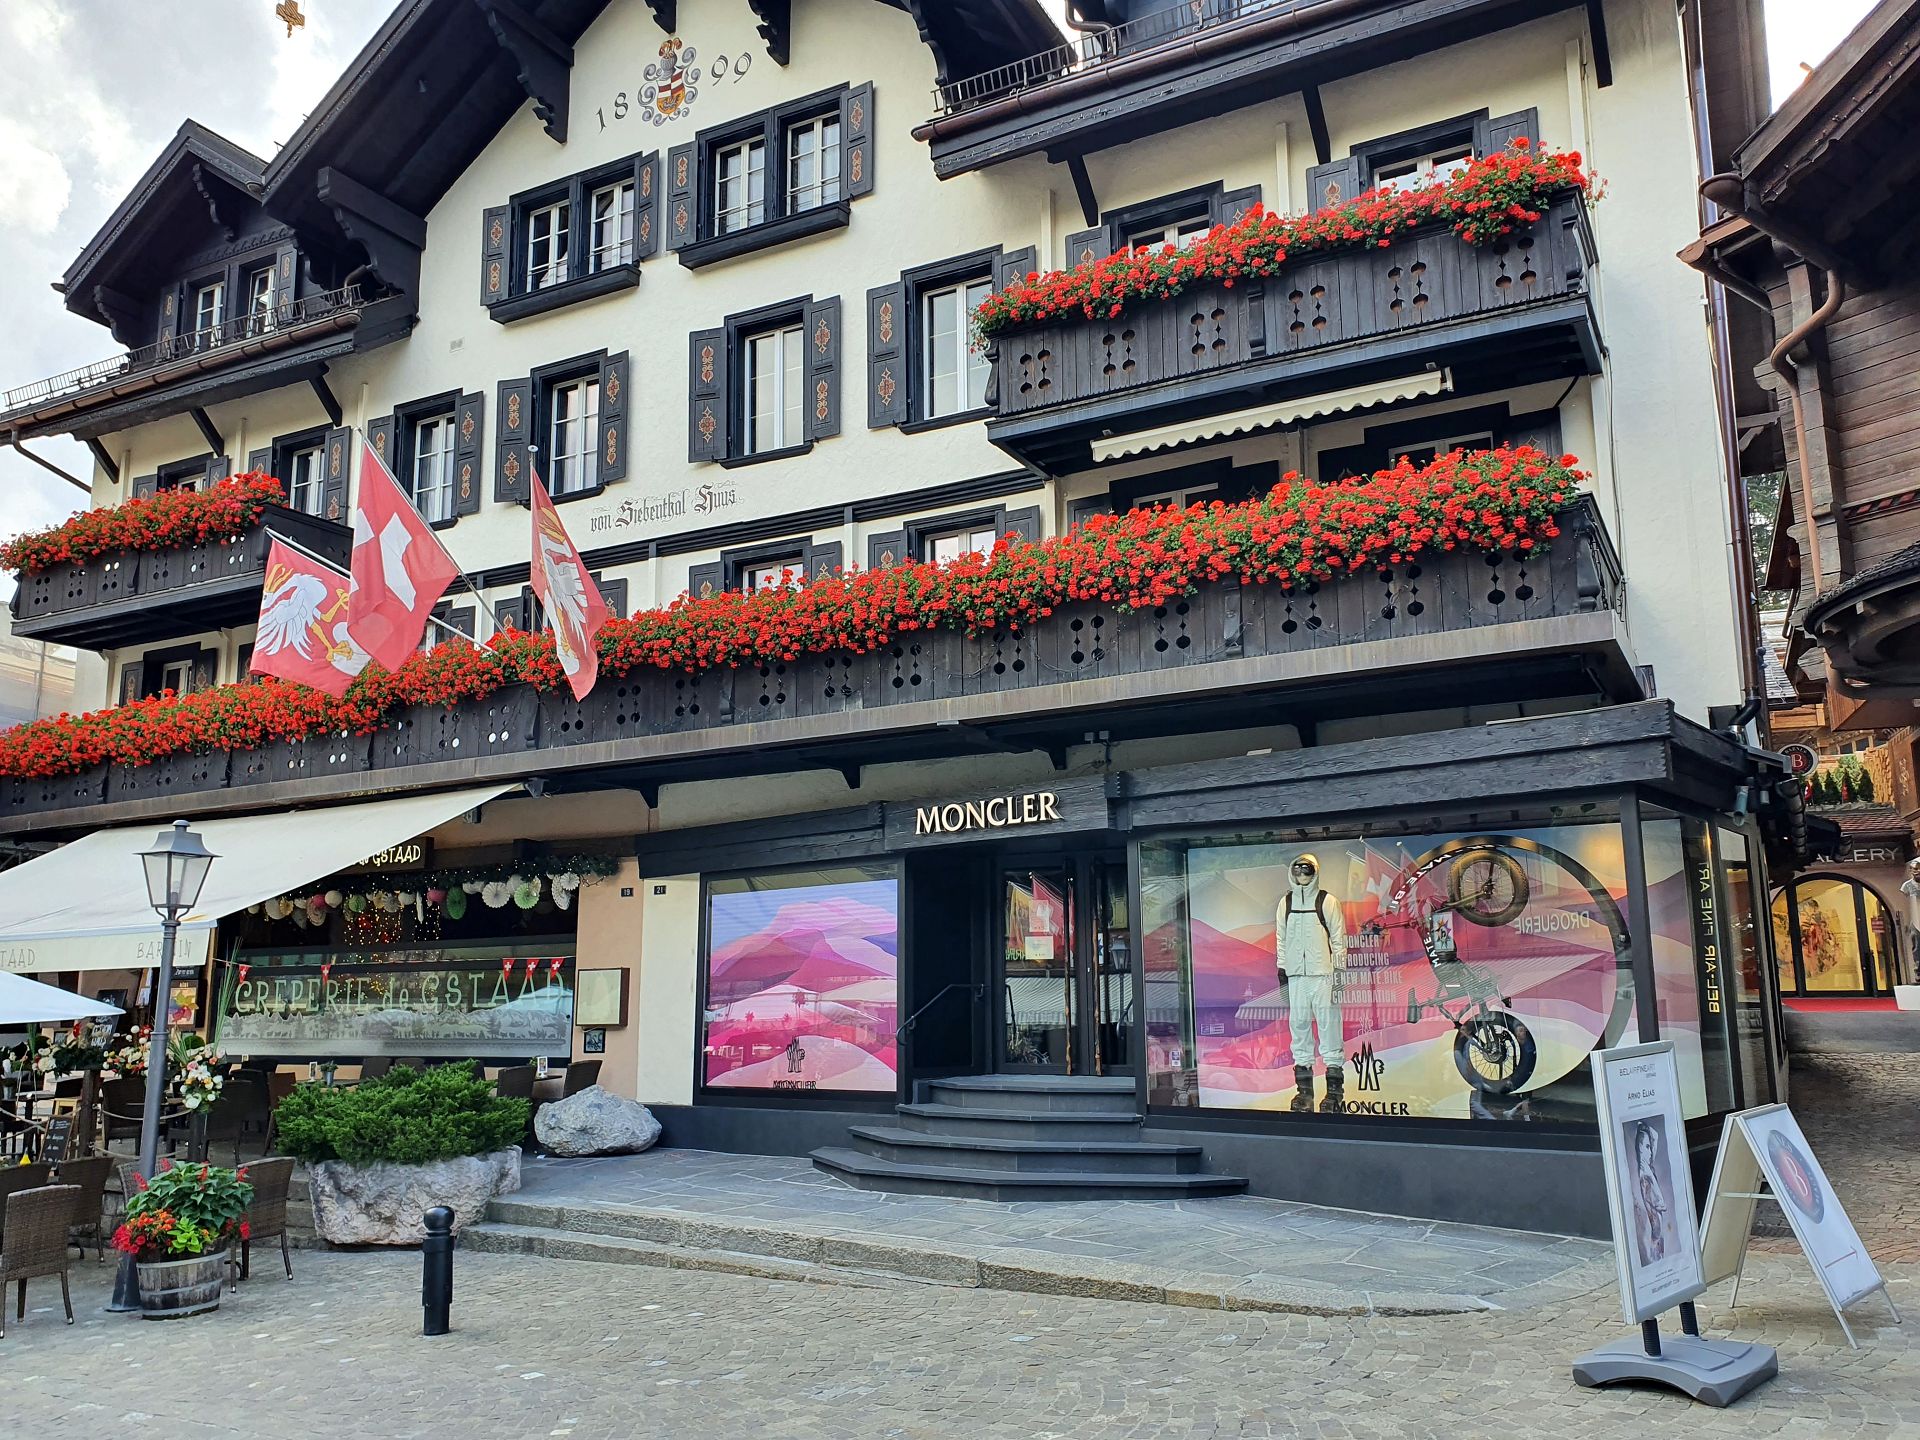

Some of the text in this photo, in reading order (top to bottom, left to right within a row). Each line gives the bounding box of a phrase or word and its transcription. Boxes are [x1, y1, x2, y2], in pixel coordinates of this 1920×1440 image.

[590, 511, 612, 533] von
[1790, 753, 1804, 768] B
[915, 792, 1063, 835] MONCLER
[372, 845, 421, 867] GSTAAD
[0, 948, 36, 968] TAAD
[136, 941, 163, 960] BAR
[1341, 970, 1358, 985] NEW
[1360, 969, 1402, 985] MATE.BIKE
[235, 969, 564, 1015] CREPERIE de GSTAAD
[1332, 989, 1397, 1004] COLLABORATION
[1333, 1100, 1410, 1116] MONCLER
